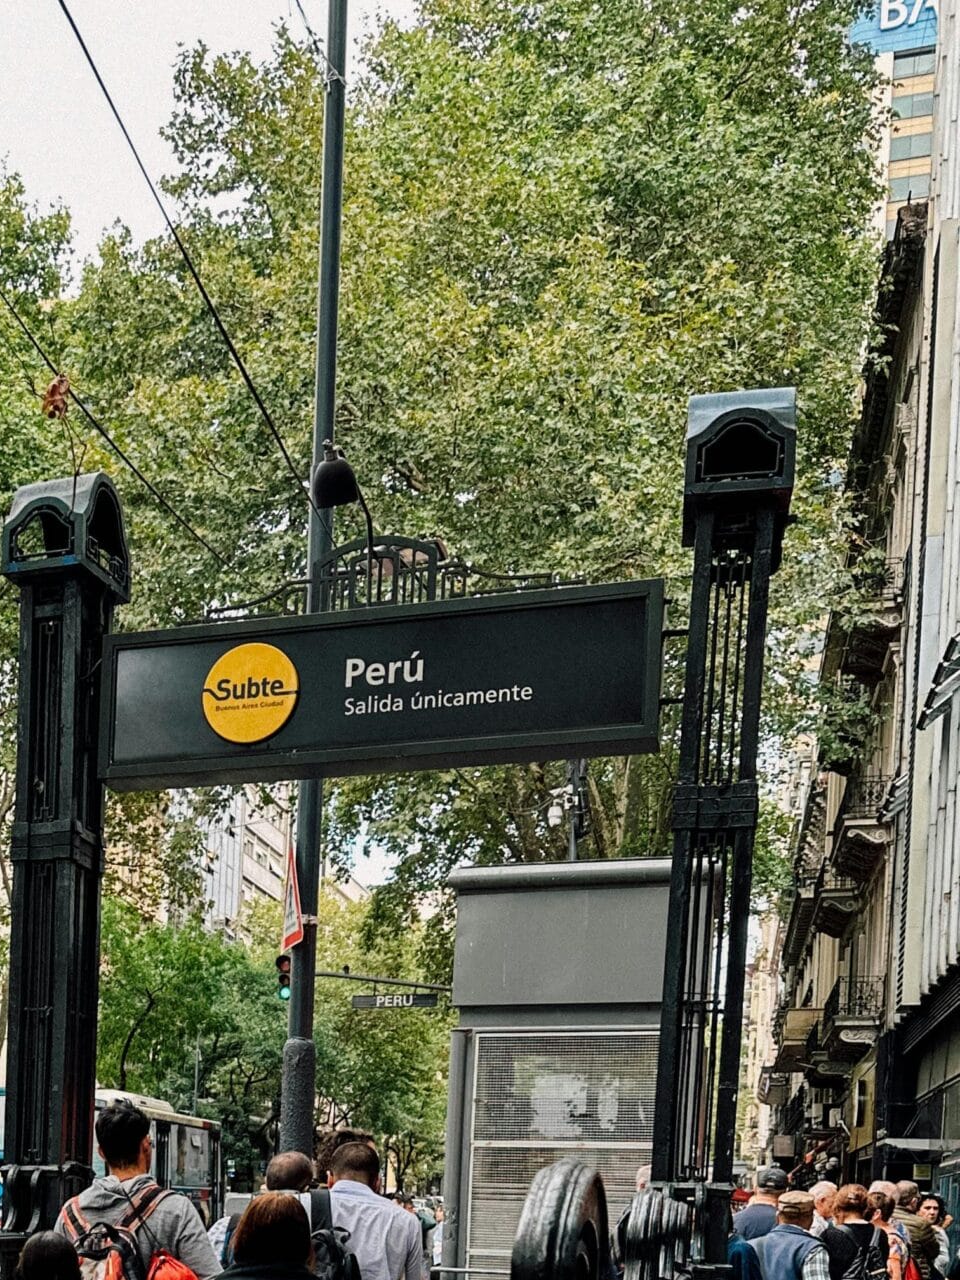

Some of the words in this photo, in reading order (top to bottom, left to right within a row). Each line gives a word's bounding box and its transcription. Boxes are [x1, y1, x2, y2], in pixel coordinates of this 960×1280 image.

[344, 650, 425, 688] Perú
[213, 676, 288, 702] Subte
[344, 693, 404, 716] Salida
[411, 685, 534, 711] únicamente
[215, 704, 240, 712] Buenos
[242, 702, 259, 710] Aires
[260, 700, 284, 708] Ciudad
[375, 994, 414, 1007] PERU
